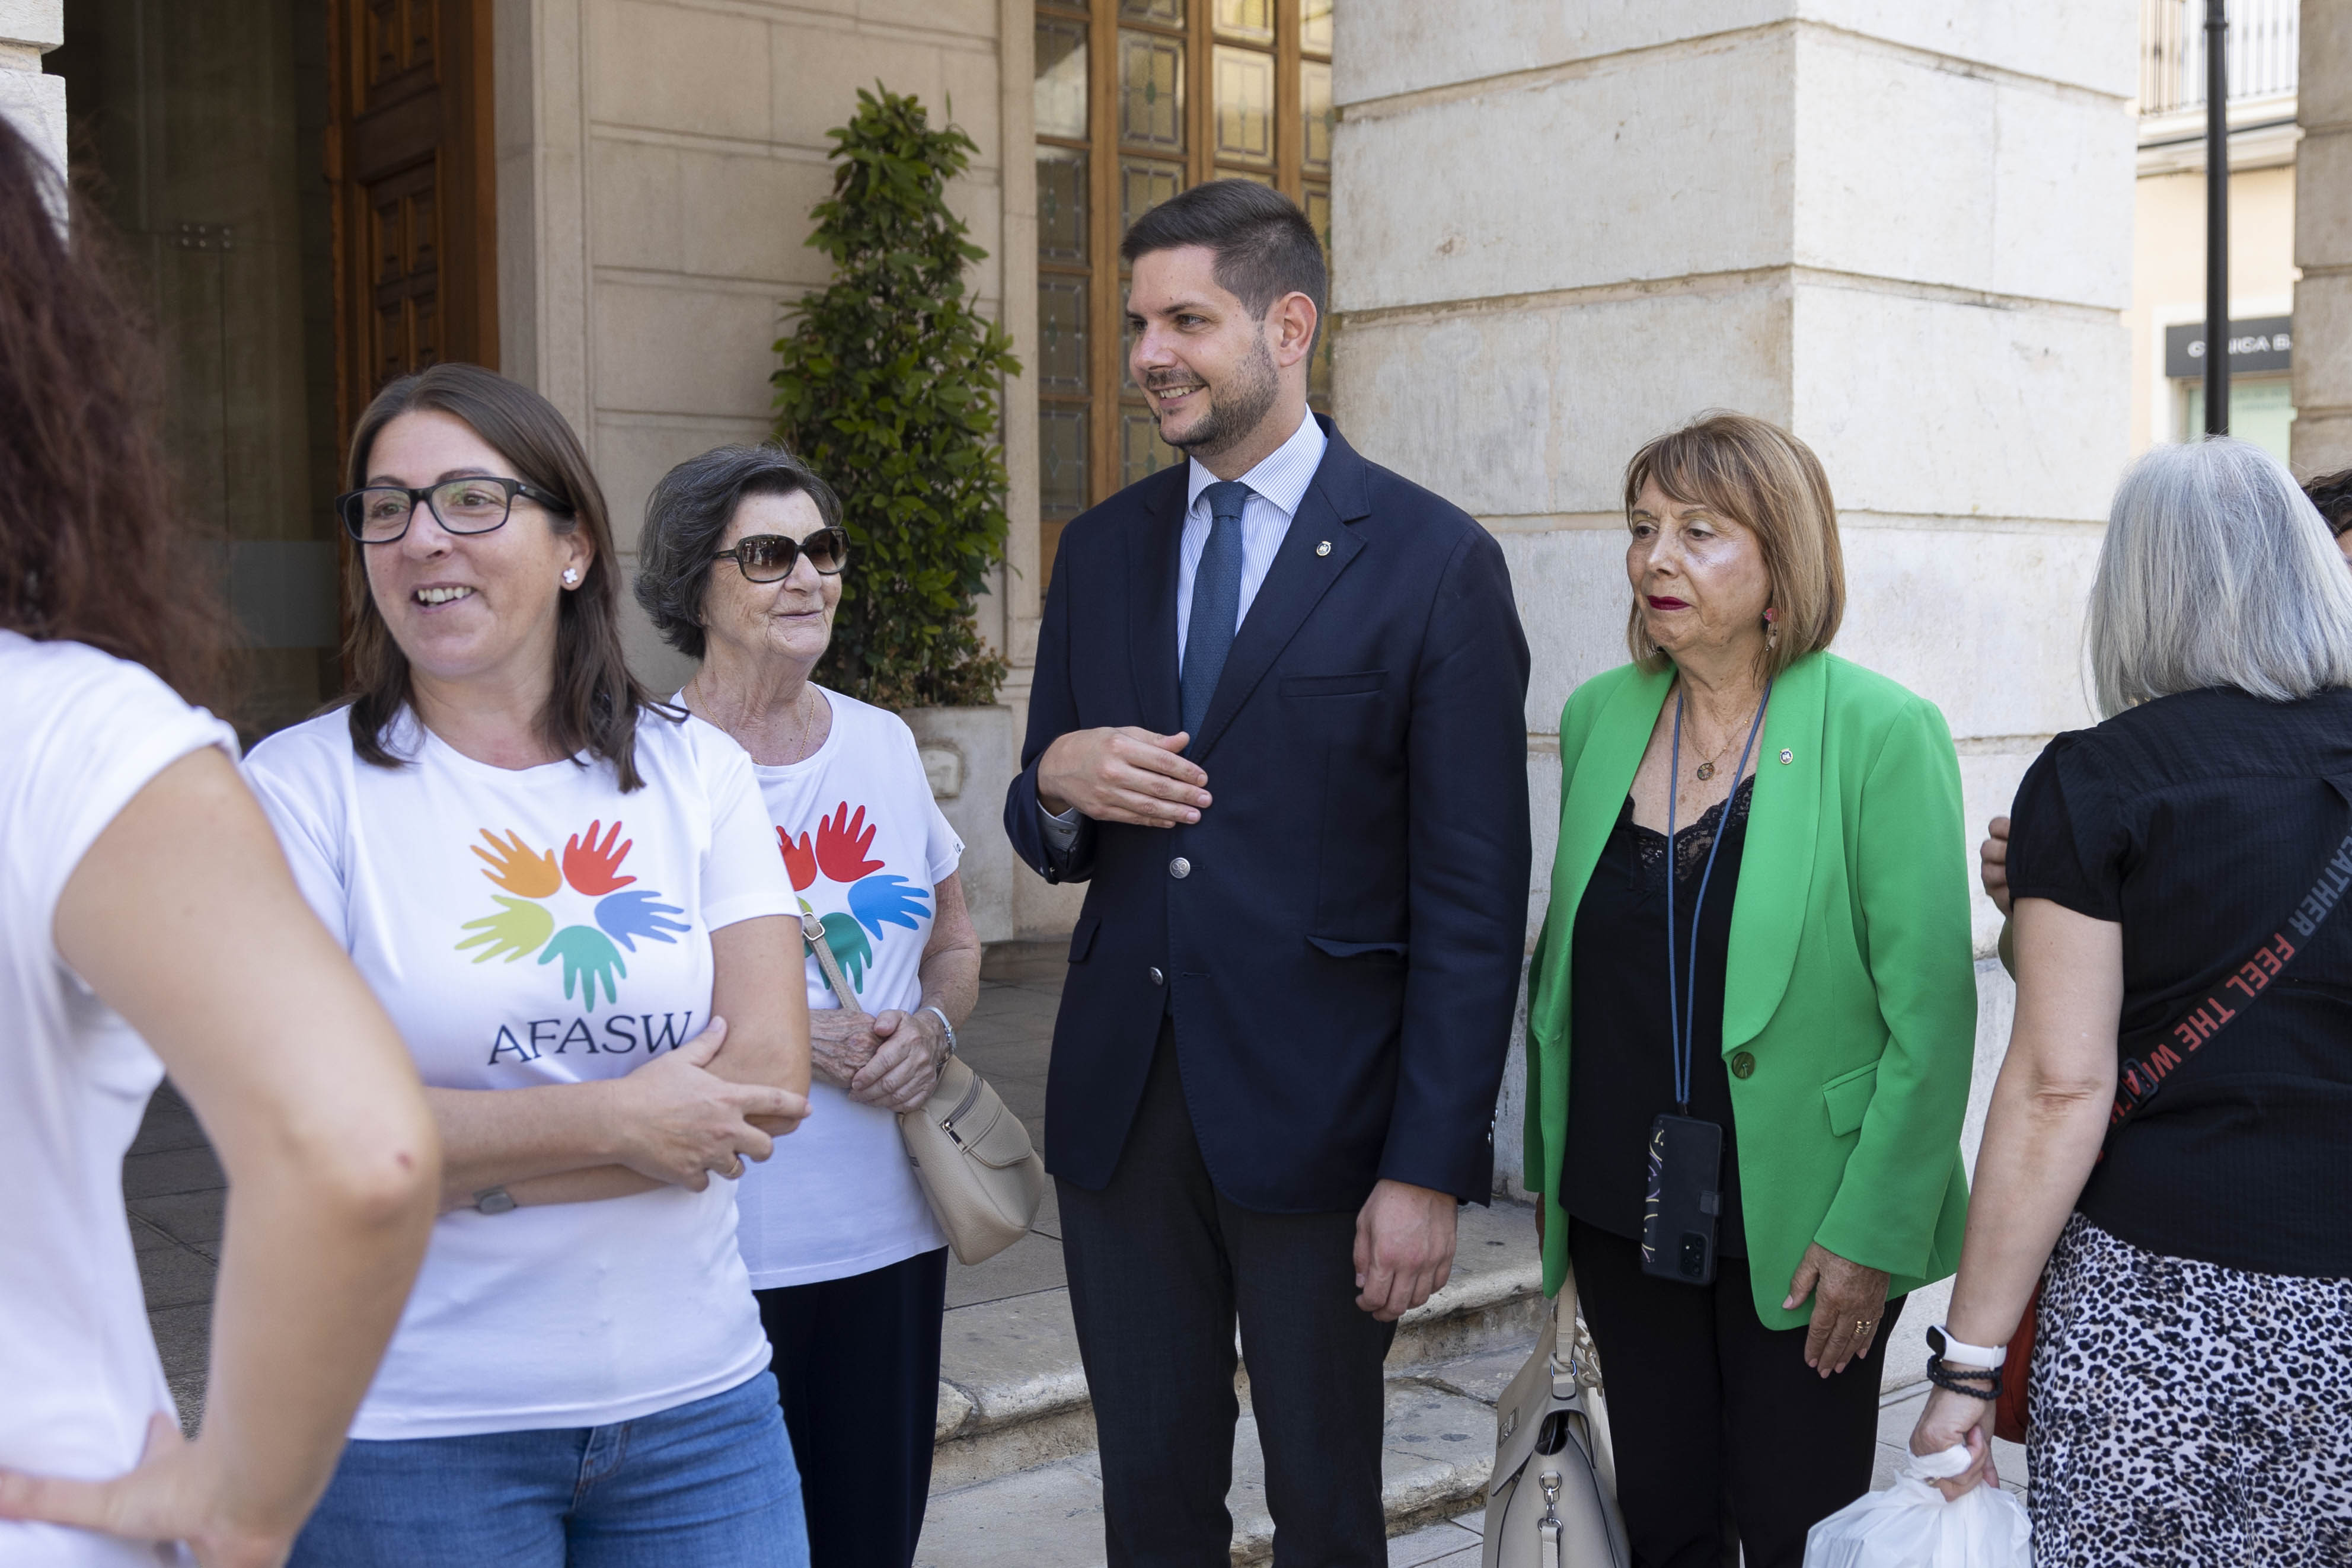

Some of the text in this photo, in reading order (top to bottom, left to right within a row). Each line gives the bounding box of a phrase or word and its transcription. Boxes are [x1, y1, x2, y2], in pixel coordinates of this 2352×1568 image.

[2273, 333, 2293, 351] B
[2225, 933, 2295, 997] FEEL
[487, 1011, 692, 1065] AFASW
[2174, 997, 2236, 1052] THE
